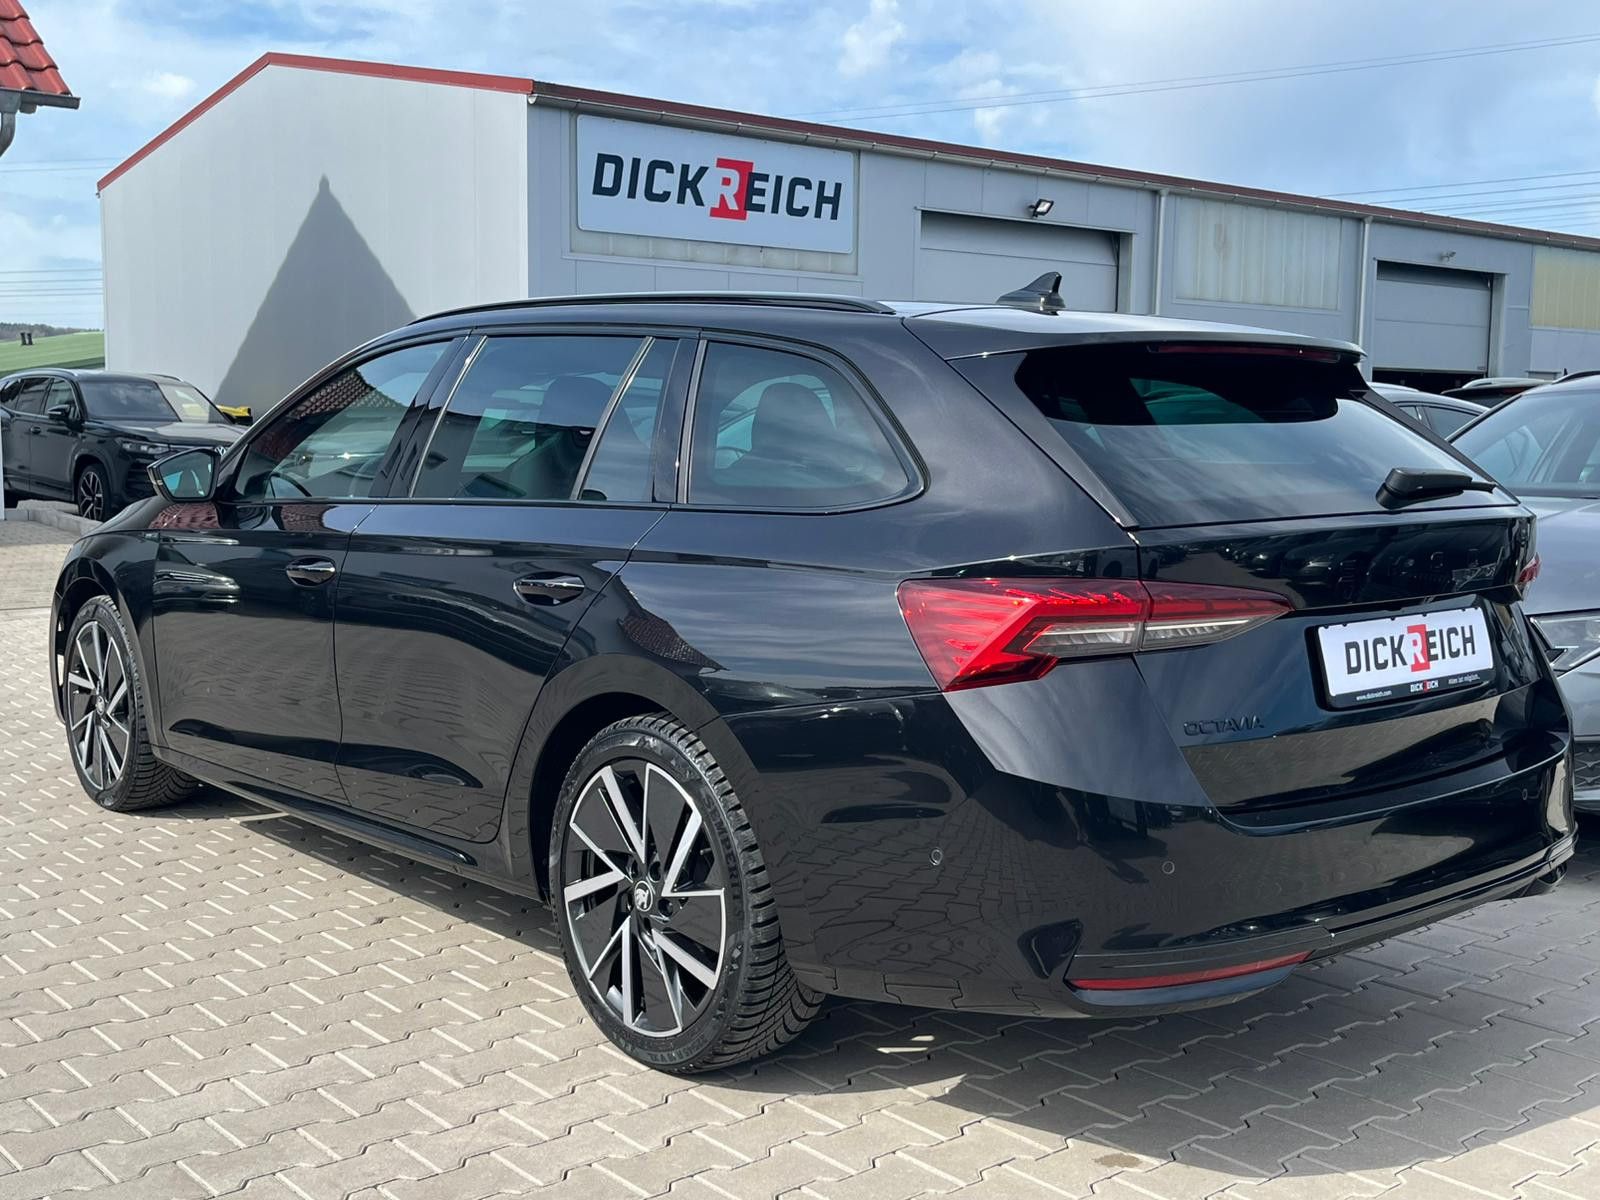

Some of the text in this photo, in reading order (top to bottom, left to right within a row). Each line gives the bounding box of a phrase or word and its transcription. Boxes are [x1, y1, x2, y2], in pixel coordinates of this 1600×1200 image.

[592, 153, 842, 221] DICKREICH
[1344, 623, 1476, 675] DICKREICH
[1184, 715, 1265, 736] OCTAVIA
